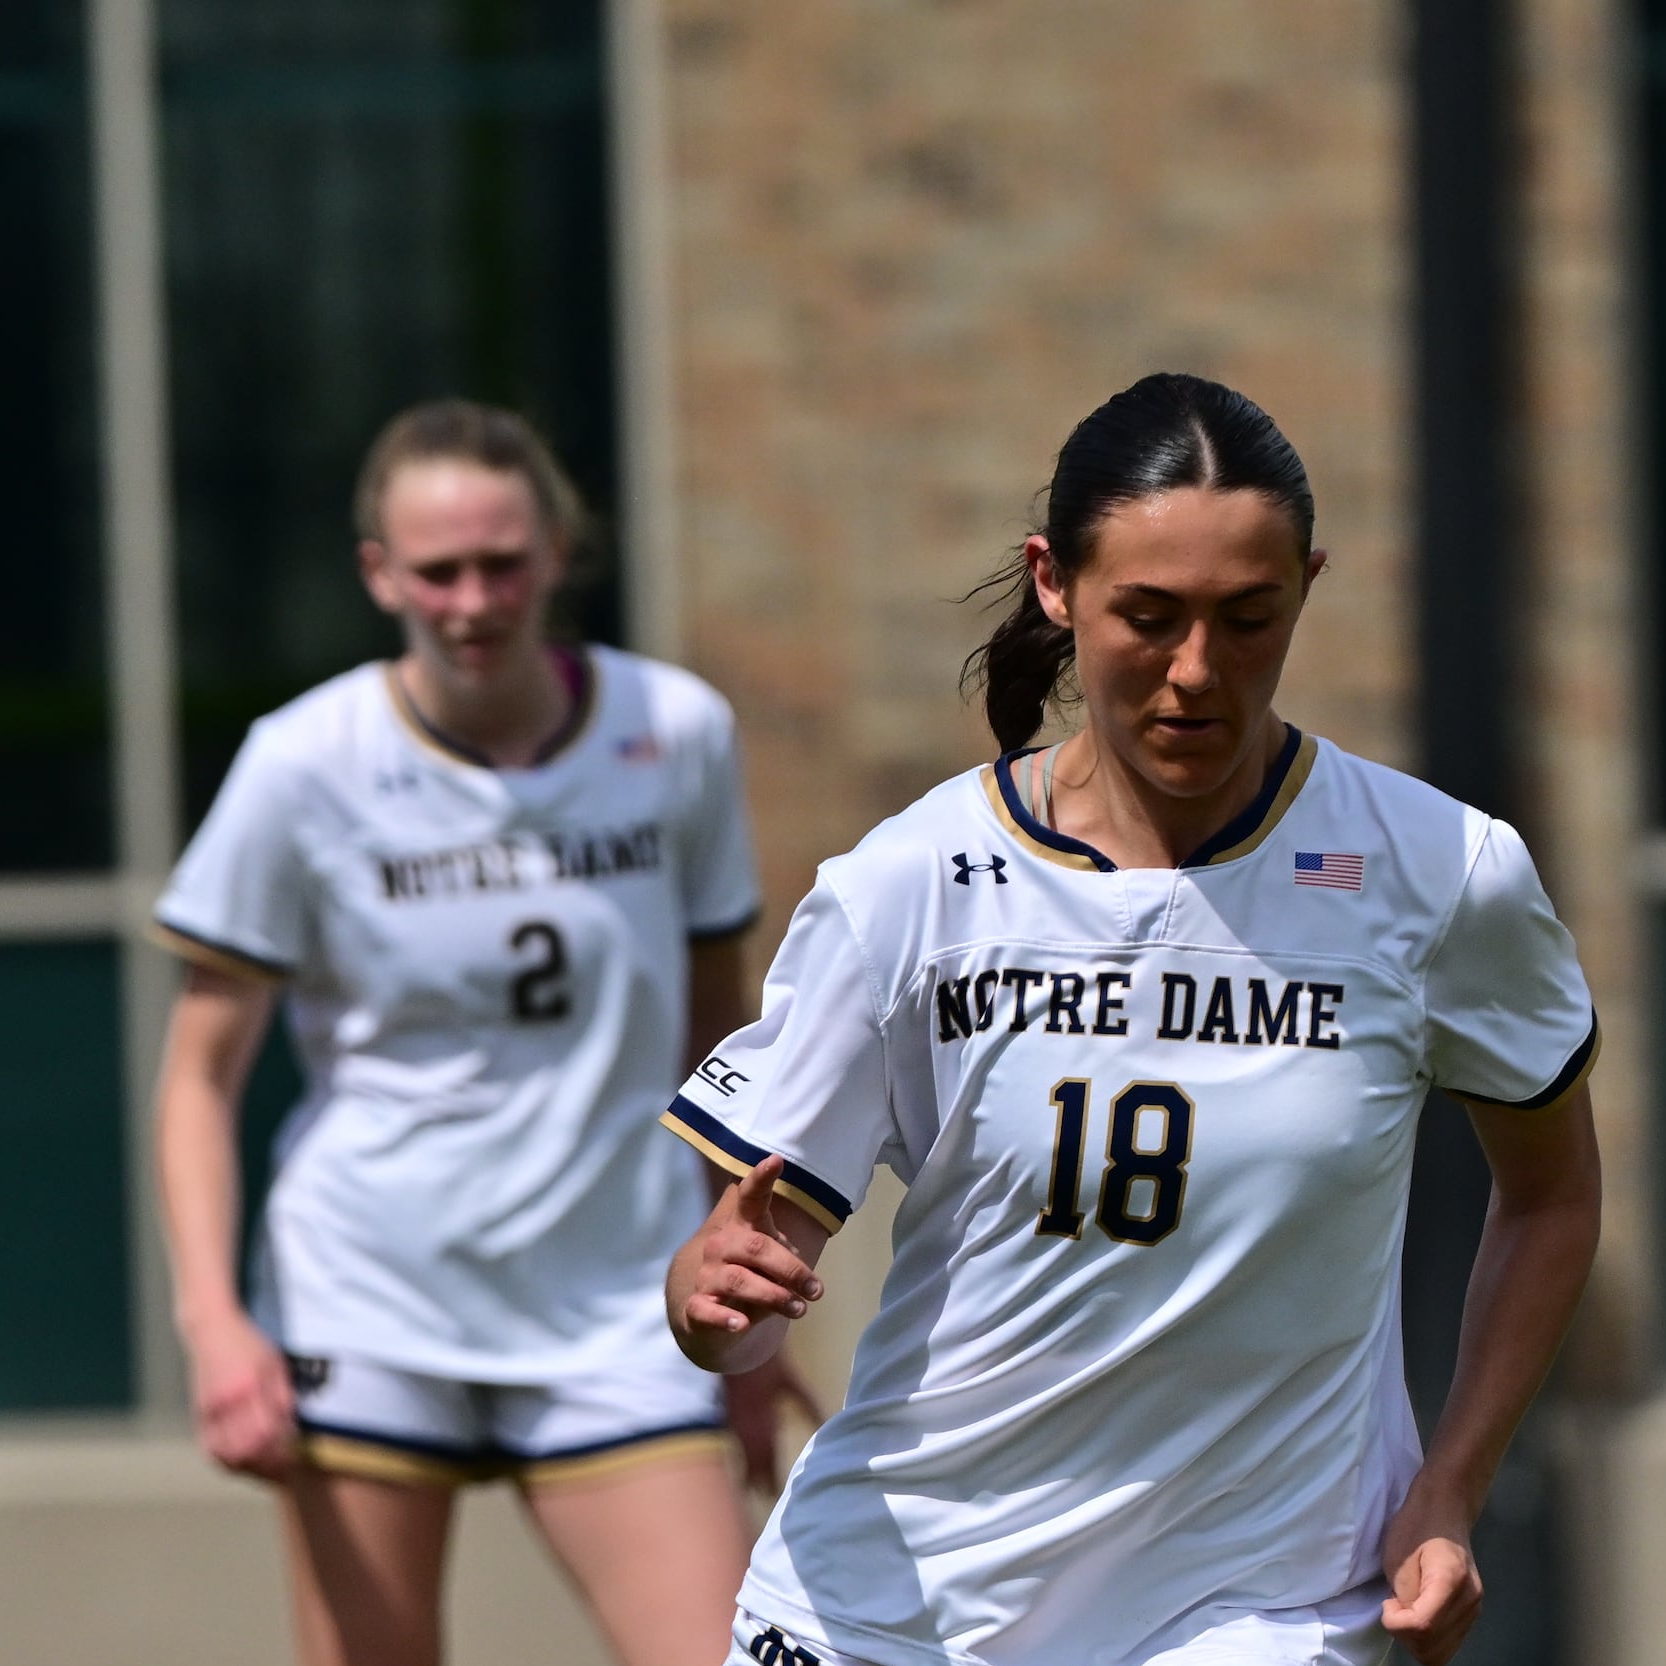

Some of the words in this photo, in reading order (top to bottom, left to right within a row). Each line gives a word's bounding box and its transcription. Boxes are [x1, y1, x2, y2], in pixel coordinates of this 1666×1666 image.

[509, 915, 573, 1026] 2
[936, 968, 1131, 1044] NOTRE
[1156, 971, 1344, 1050] DAME
[695, 1056, 751, 1096] CC
[1035, 1076, 1196, 1247] 18
